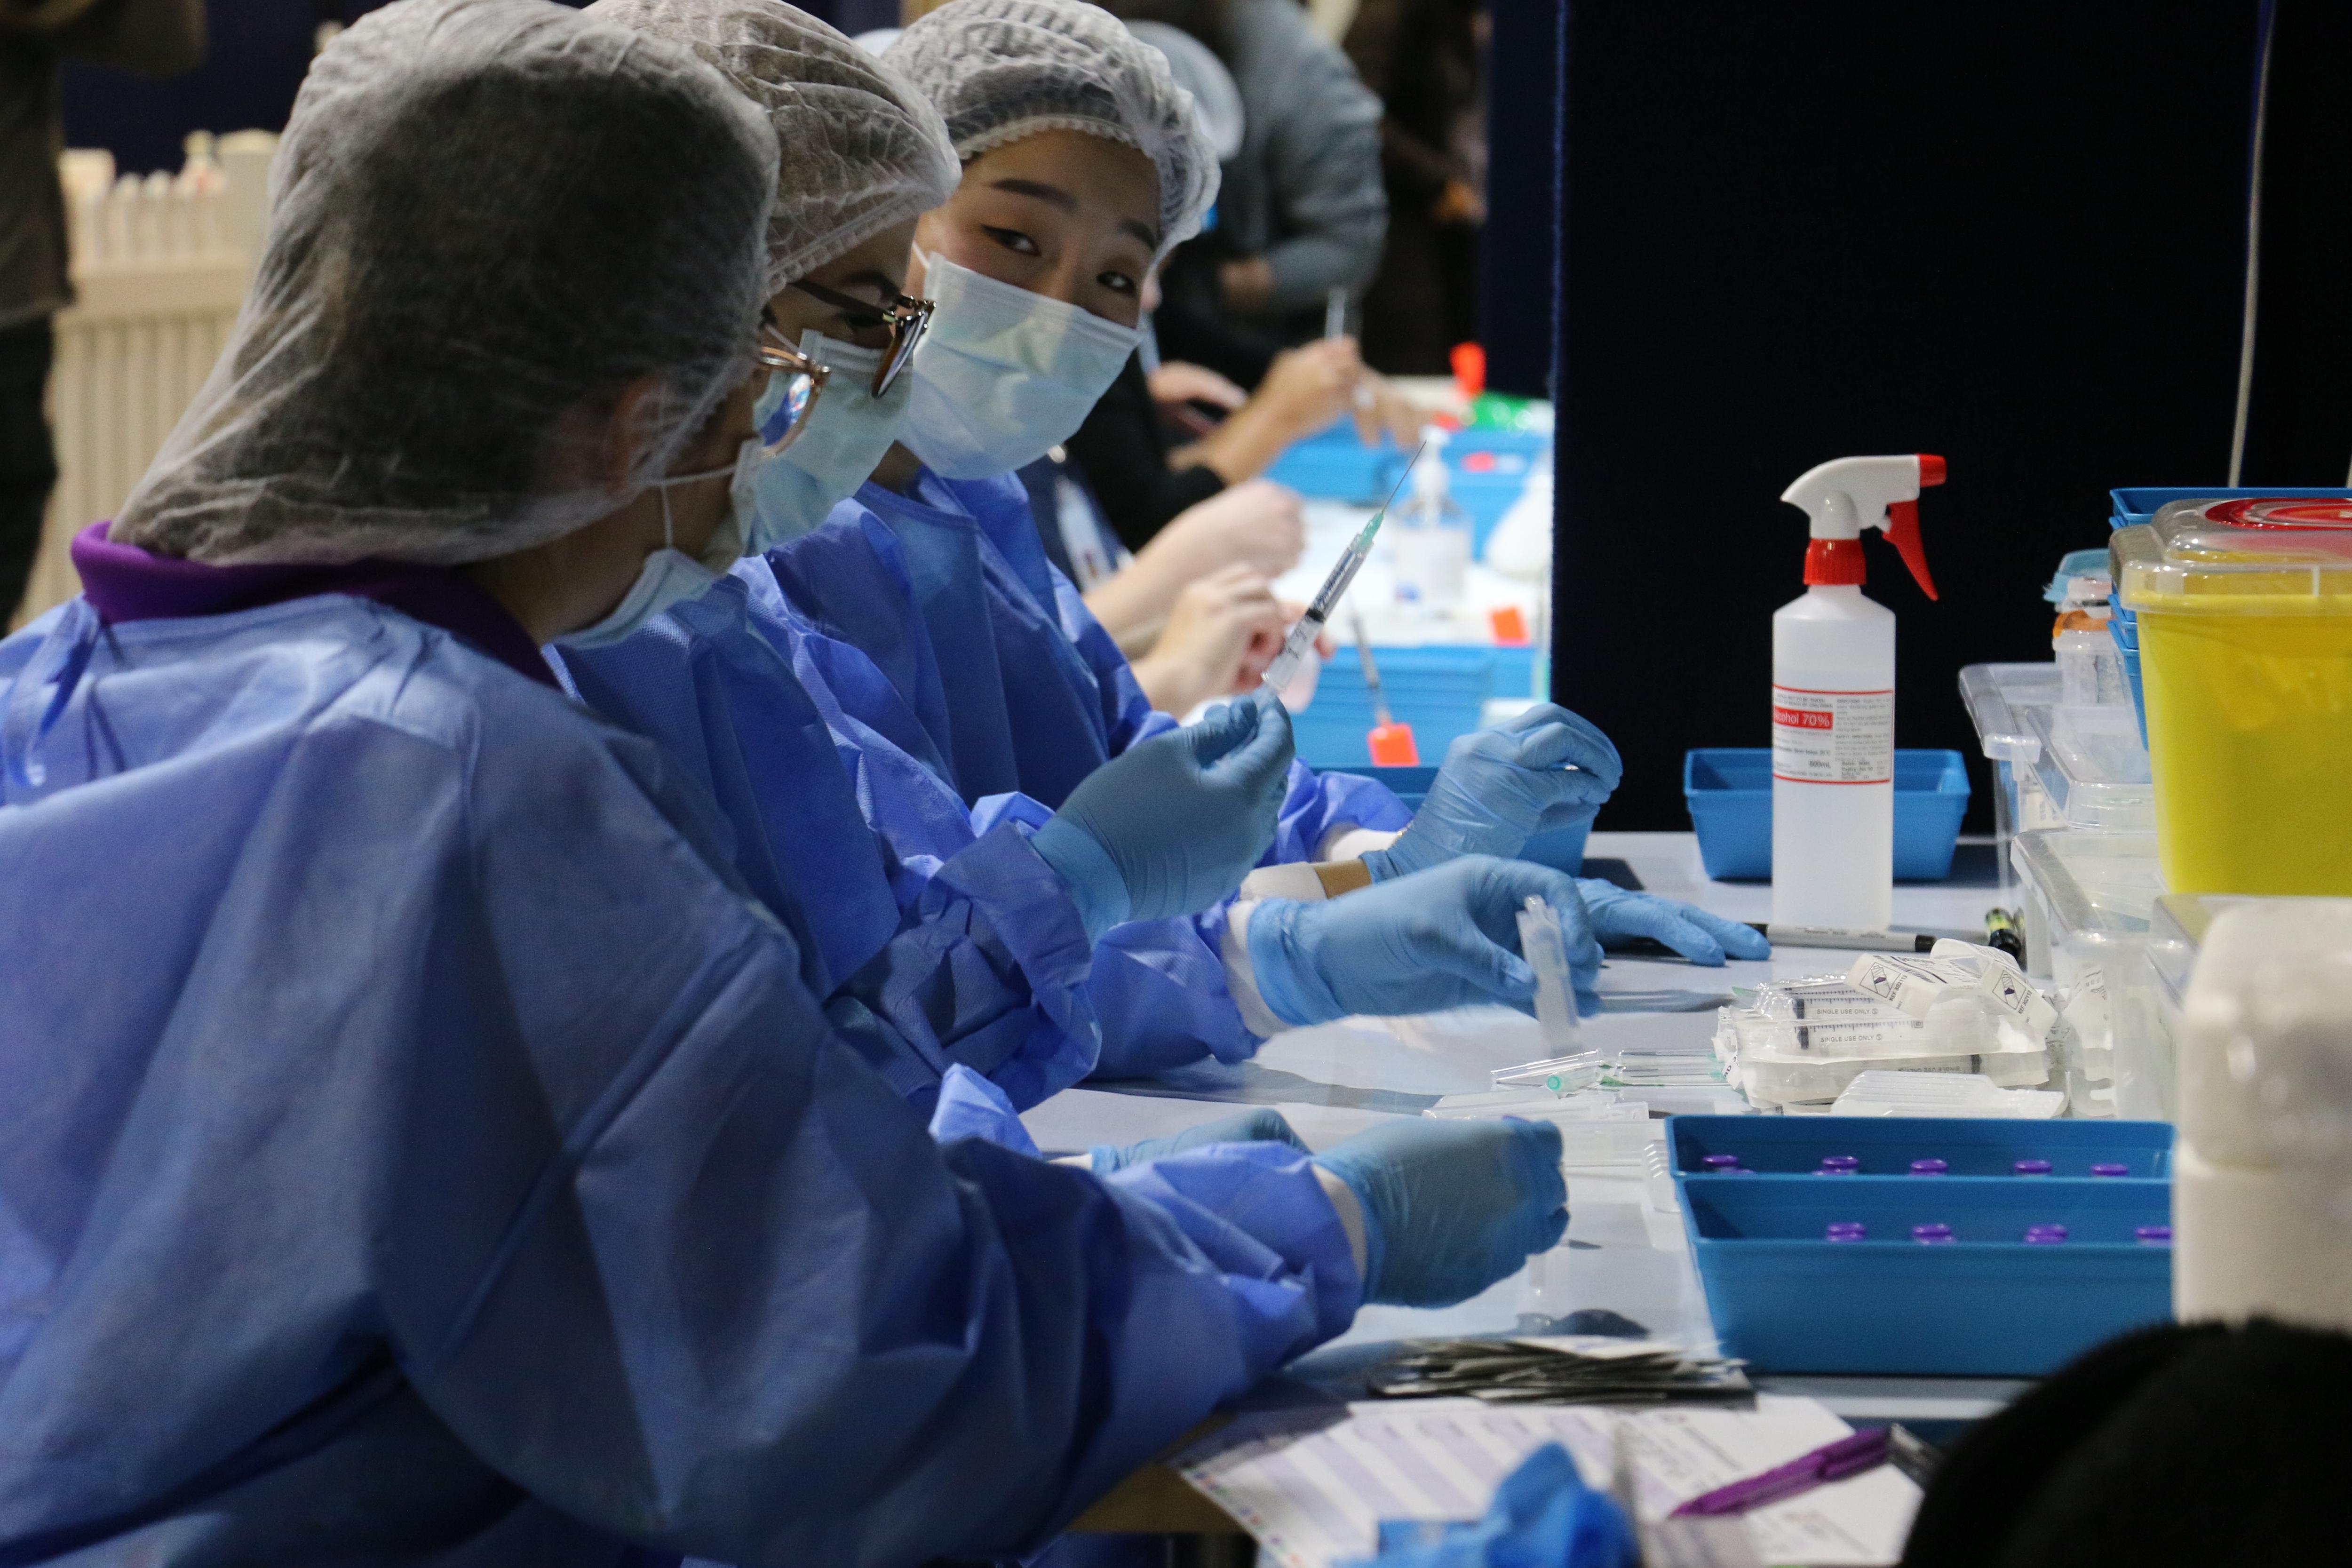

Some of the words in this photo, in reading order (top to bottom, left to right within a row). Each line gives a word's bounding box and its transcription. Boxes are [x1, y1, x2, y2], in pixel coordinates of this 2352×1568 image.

[1803, 714, 1830, 726] 70%
[1895, 975, 1907, 991] 302113
[2023, 990, 2032, 1005] 302113
